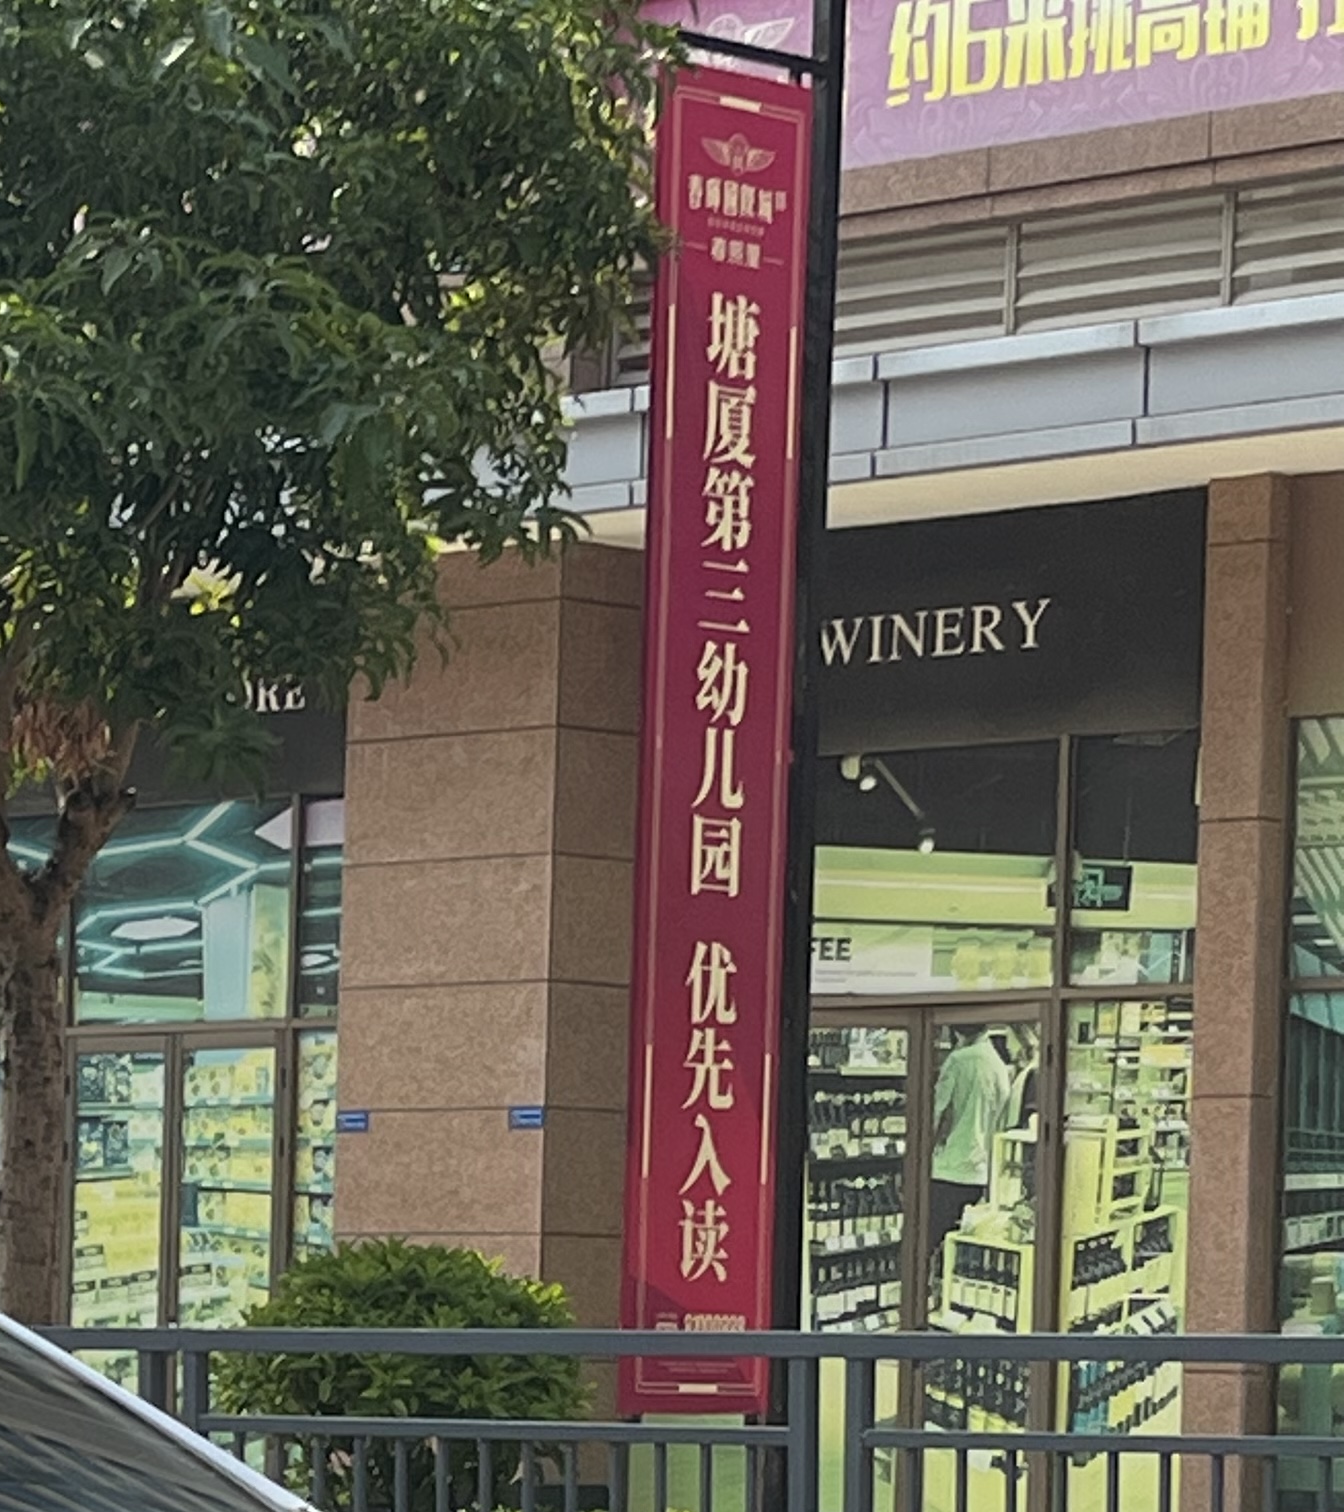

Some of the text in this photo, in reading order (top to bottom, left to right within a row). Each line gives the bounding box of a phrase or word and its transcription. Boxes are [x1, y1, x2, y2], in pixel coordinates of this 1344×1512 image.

[690, 291, 761, 898] 塘厦第三幼儿园
[821, 598, 1051, 666] WINERY
[678, 941, 738, 1283] 优先入读
